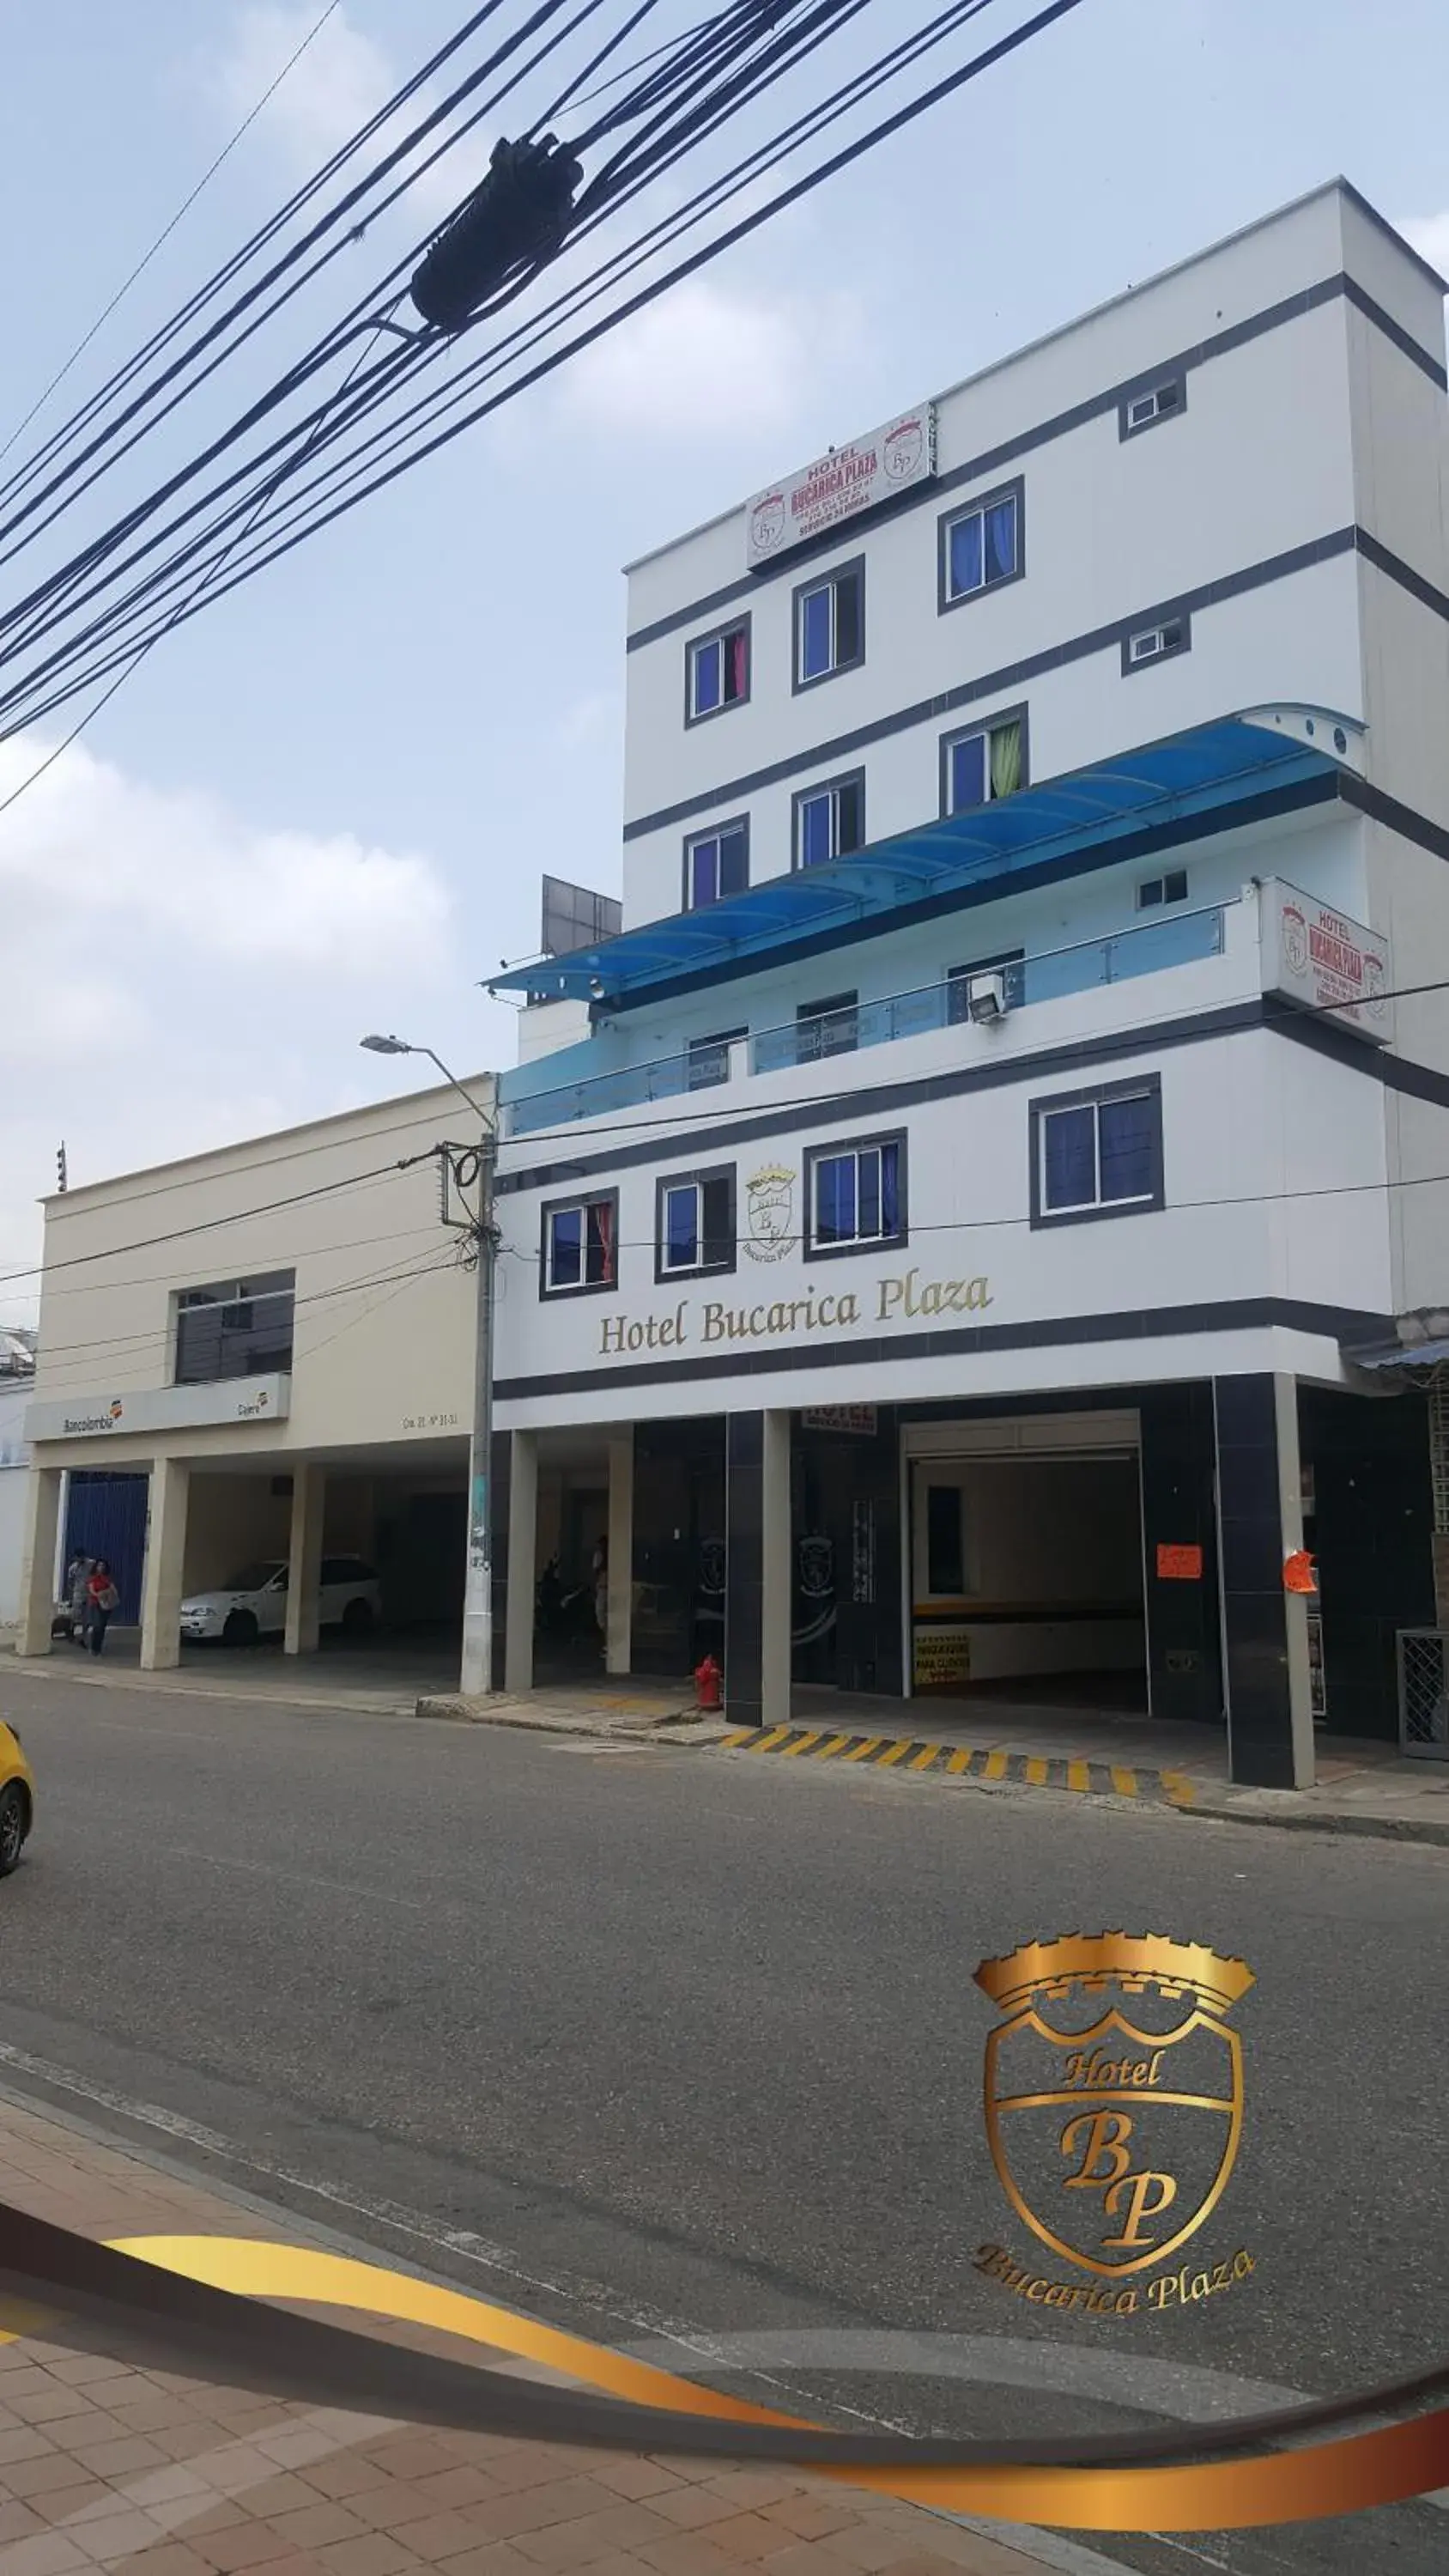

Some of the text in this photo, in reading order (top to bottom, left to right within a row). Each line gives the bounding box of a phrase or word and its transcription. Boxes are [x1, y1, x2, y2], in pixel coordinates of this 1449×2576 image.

[808, 448, 858, 481] HOTEL
[791, 471, 843, 513] BUCARICA
[845, 453, 877, 483] PLAZA
[1319, 910, 1350, 941] HOTEL
[598, 1267, 994, 1354] Hotel Bucarica Plaza
[64, 1414, 114, 1433] Bancolombia
